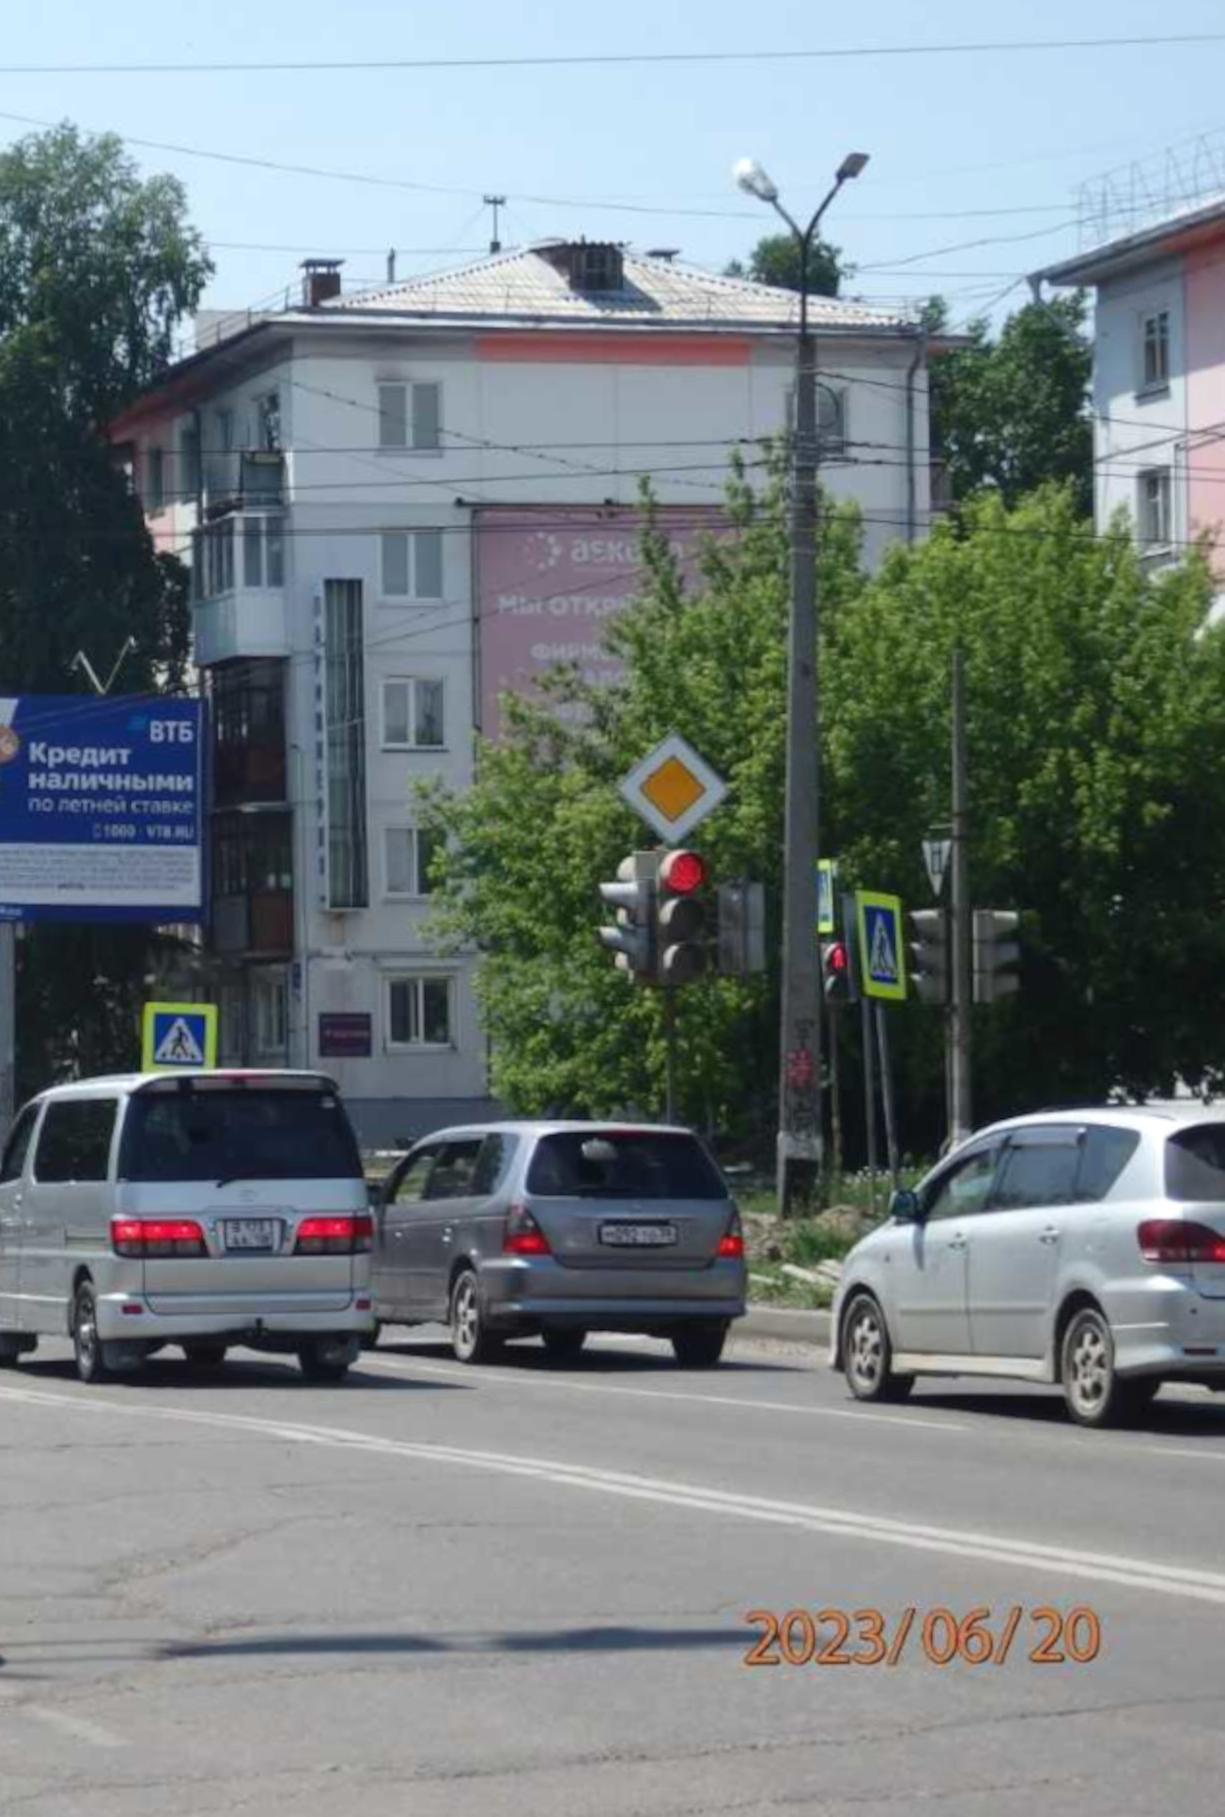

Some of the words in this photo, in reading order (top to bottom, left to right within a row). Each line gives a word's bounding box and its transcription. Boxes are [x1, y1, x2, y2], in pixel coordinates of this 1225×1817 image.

[149, 719, 194, 742] ВТБ
[28, 741, 131, 769] Кредит
[28, 771, 194, 792] наличными
[28, 797, 54, 813] по
[57, 795, 127, 814] летней
[130, 799, 194, 815] ставке
